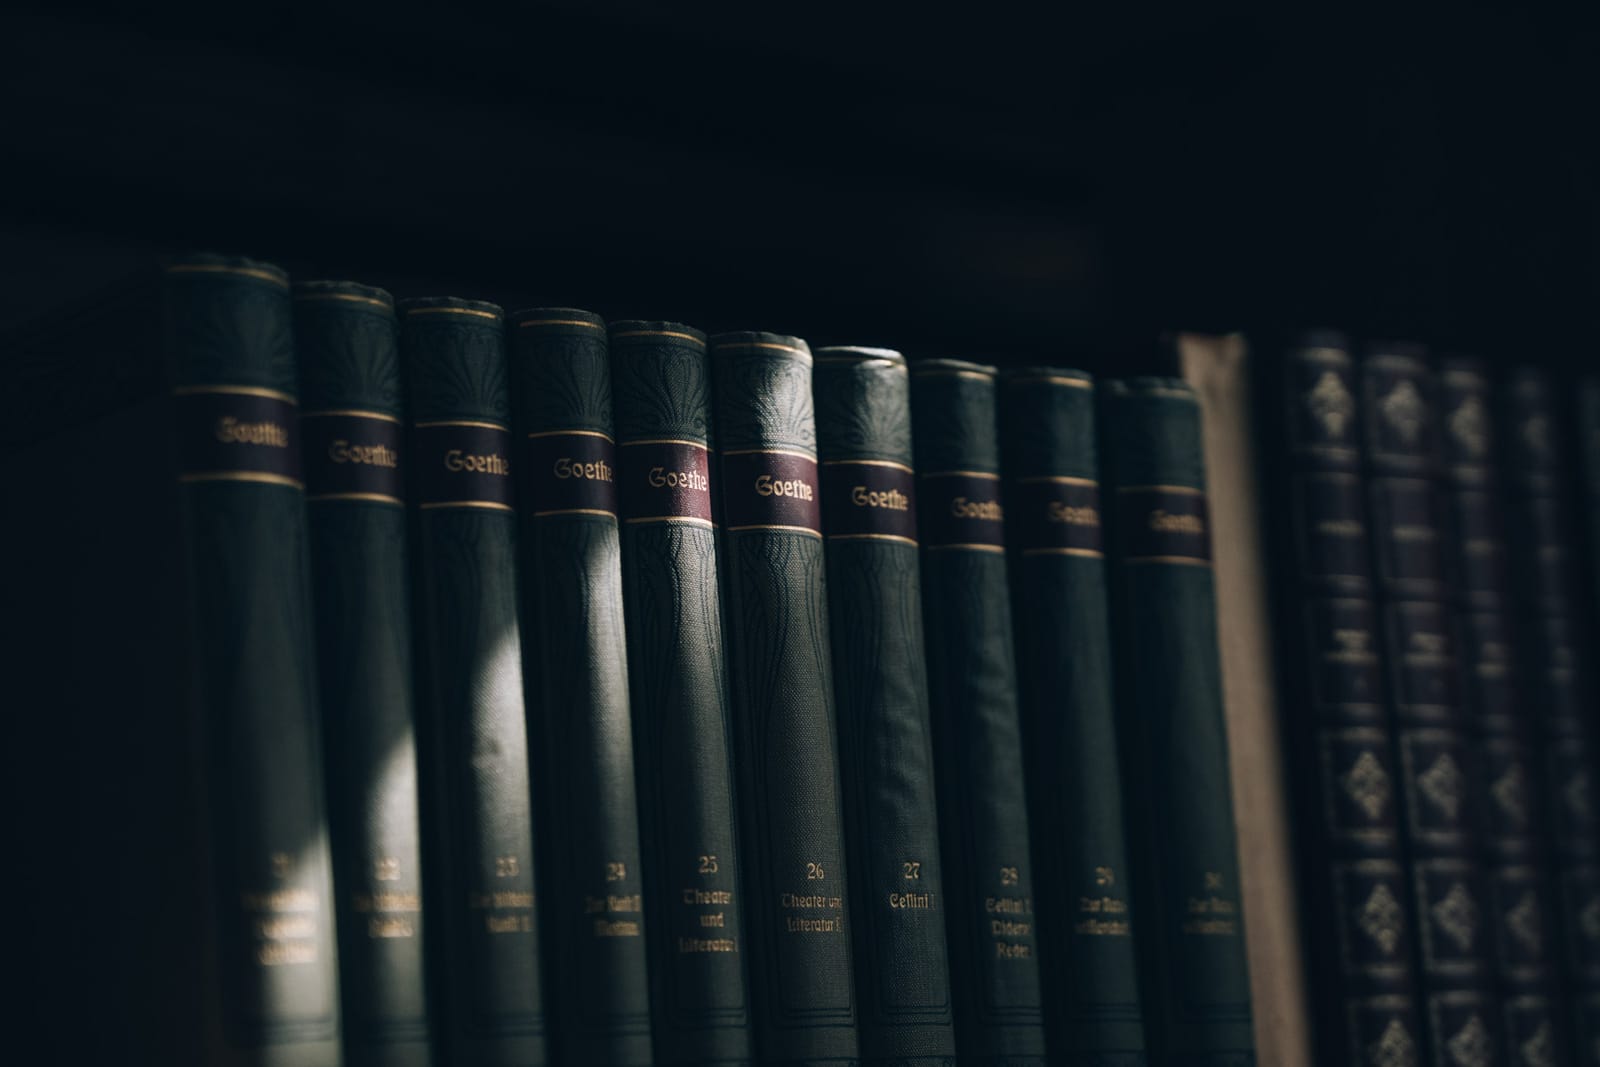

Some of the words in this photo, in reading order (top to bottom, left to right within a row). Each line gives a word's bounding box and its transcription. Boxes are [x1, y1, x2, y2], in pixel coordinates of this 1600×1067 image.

[329, 439, 397, 468] Goethe
[445, 449, 509, 476] Goethe
[554, 457, 613, 483] Goethe
[648, 465, 708, 492] Goethe
[755, 474, 813, 502] Goethe
[852, 485, 908, 511] Goethe
[952, 497, 1003, 522] Goeth
[698, 855, 719, 874] 25
[806, 862, 825, 880] 26
[903, 861, 921, 880] 27
[1000, 867, 1018, 886] 28
[683, 887, 732, 905] Theater
[782, 891, 826, 908] Theater
[889, 892, 929, 909] Cellini
[699, 911, 725, 928] und
[786, 916, 833, 932] Literatur
